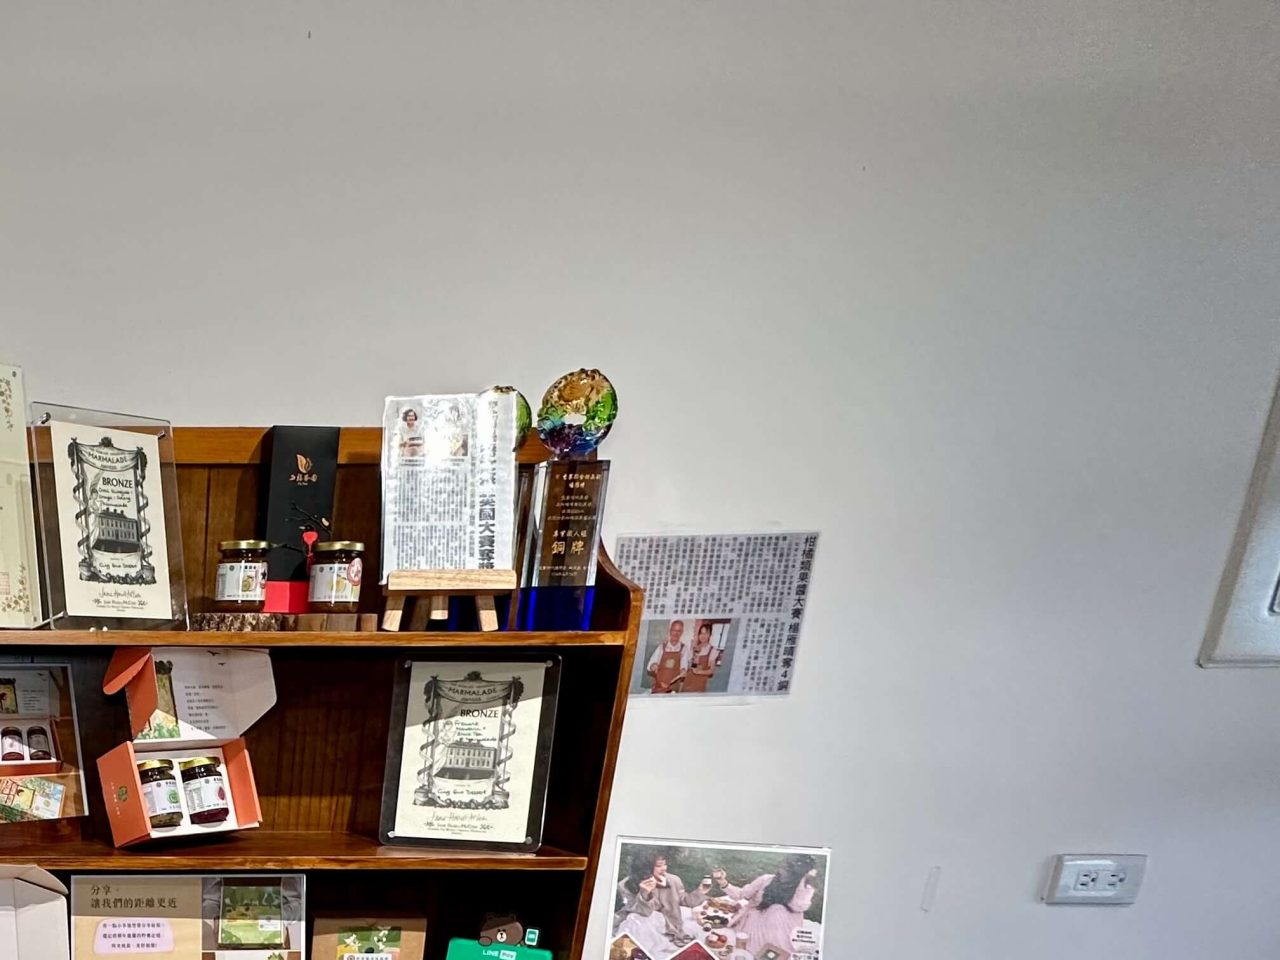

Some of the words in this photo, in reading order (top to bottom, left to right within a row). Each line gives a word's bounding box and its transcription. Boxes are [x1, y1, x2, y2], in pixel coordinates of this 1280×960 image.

[102, 477, 133, 489] BRONZE
[448, 687, 498, 696] MARMALADE
[460, 708, 499, 718] BRONZE
[90, 897, 178, 909] 讓我們的距離更近
[482, 949, 499, 957] LINE
